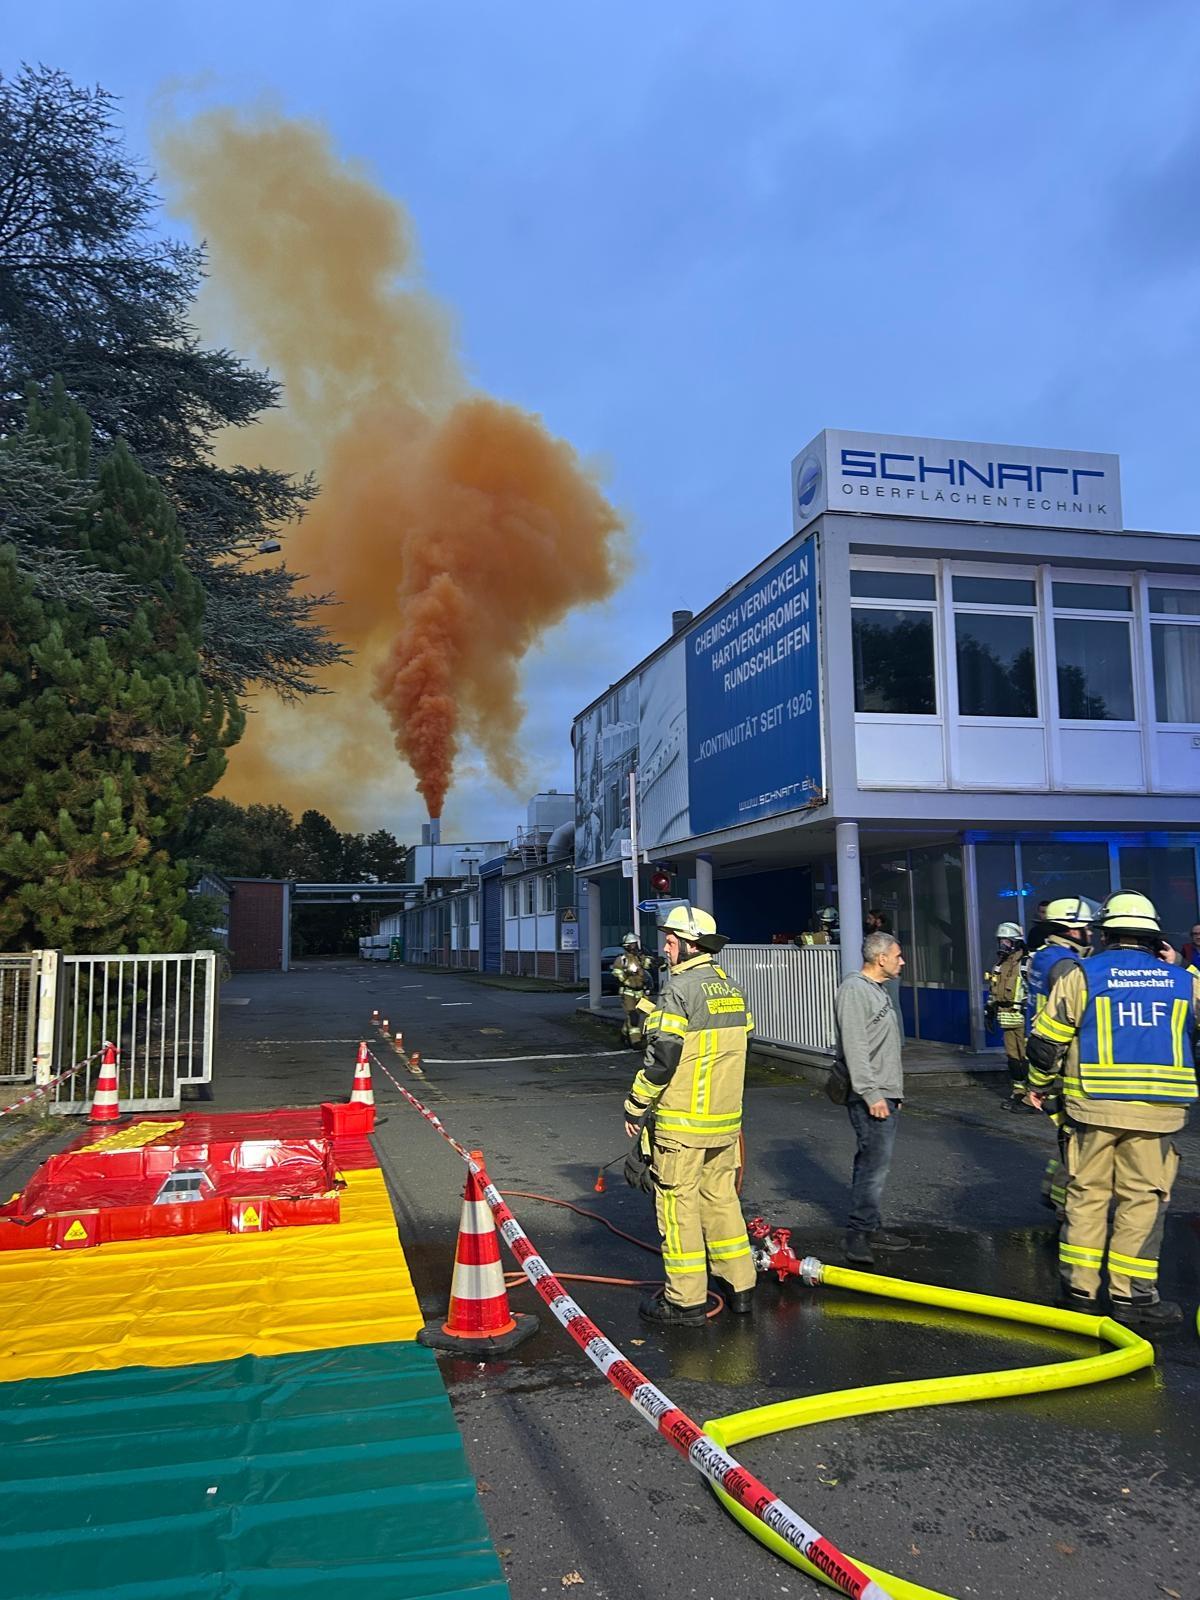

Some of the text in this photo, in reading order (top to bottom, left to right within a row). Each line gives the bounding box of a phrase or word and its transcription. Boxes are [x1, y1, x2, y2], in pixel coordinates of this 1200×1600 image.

[842, 483, 1108, 515] OBERFLÄCHENTECHNIK
[695, 555, 809, 655] CHEMISCH VERNICKELN
[711, 588, 809, 672] HARTVERCHROMEN
[724, 622, 810, 692] RUNDSCHLEIFEN
[760, 703, 783, 733] SEIT
[786, 689, 813, 720] 1926
[1108, 978, 1175, 988] Mainaschaff
[1110, 968, 1169, 977] Feuerwehr
[1118, 1002, 1167, 1027] HLF
